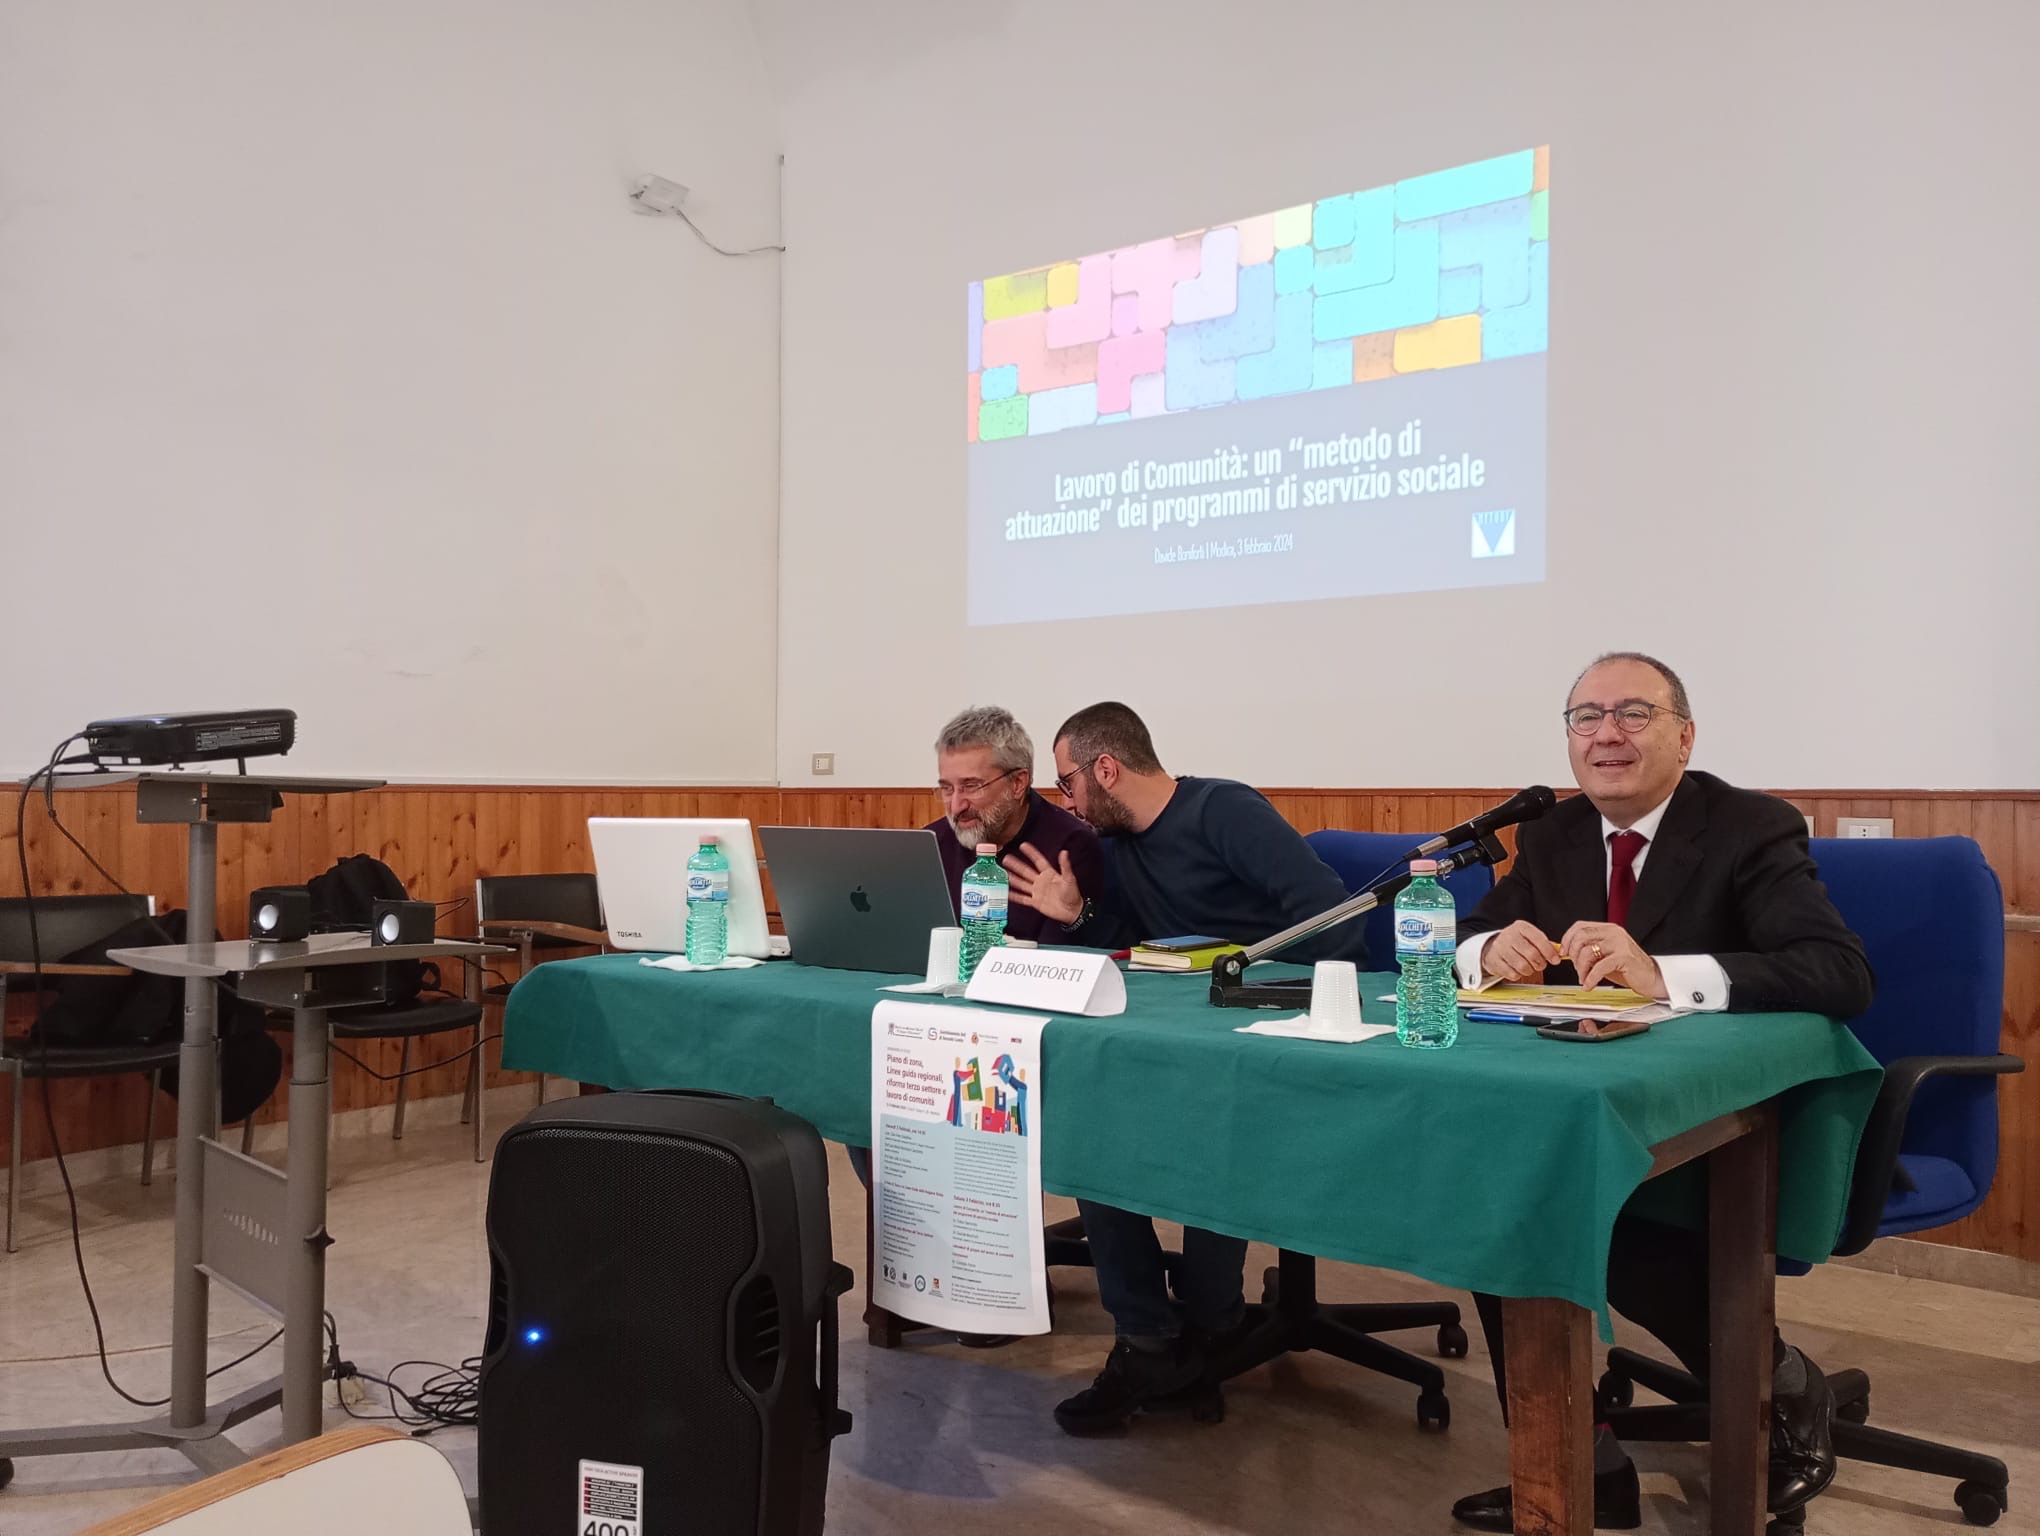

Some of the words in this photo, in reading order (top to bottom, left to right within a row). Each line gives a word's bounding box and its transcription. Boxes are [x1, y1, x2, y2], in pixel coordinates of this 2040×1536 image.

[1055, 471, 1116, 502] Lavoro
[1121, 459, 1139, 494] di
[1144, 445, 1248, 491] Comunità:
[1254, 447, 1281, 476] un
[1289, 427, 1392, 470] “metodo
[1398, 418, 1421, 457] di
[1005, 499, 1112, 541] attuazione”
[1117, 494, 1147, 528] dei
[1152, 478, 1270, 532] programmi
[1276, 473, 1297, 510] di
[1303, 464, 1391, 507] servizio
[1397, 452, 1485, 496] sociale
[1273, 533, 1293, 552] 2024
[990, 961, 1084, 983] D.BONIFORTI
[886, 1054, 903, 1065] Piano
[903, 1055, 909, 1065] di
[886, 1067, 901, 1077] Linee
[902, 1067, 917, 1081] guida
[917, 1072, 943, 1084] regionali,
[886, 1078, 906, 1089] riforma
[906, 1082, 920, 1091] terzo
[921, 1084, 942, 1095] settore
[886, 1090, 902, 1100] lavoro
[902, 1093, 908, 1102] di
[584, 1521, 629, 1536] 400
